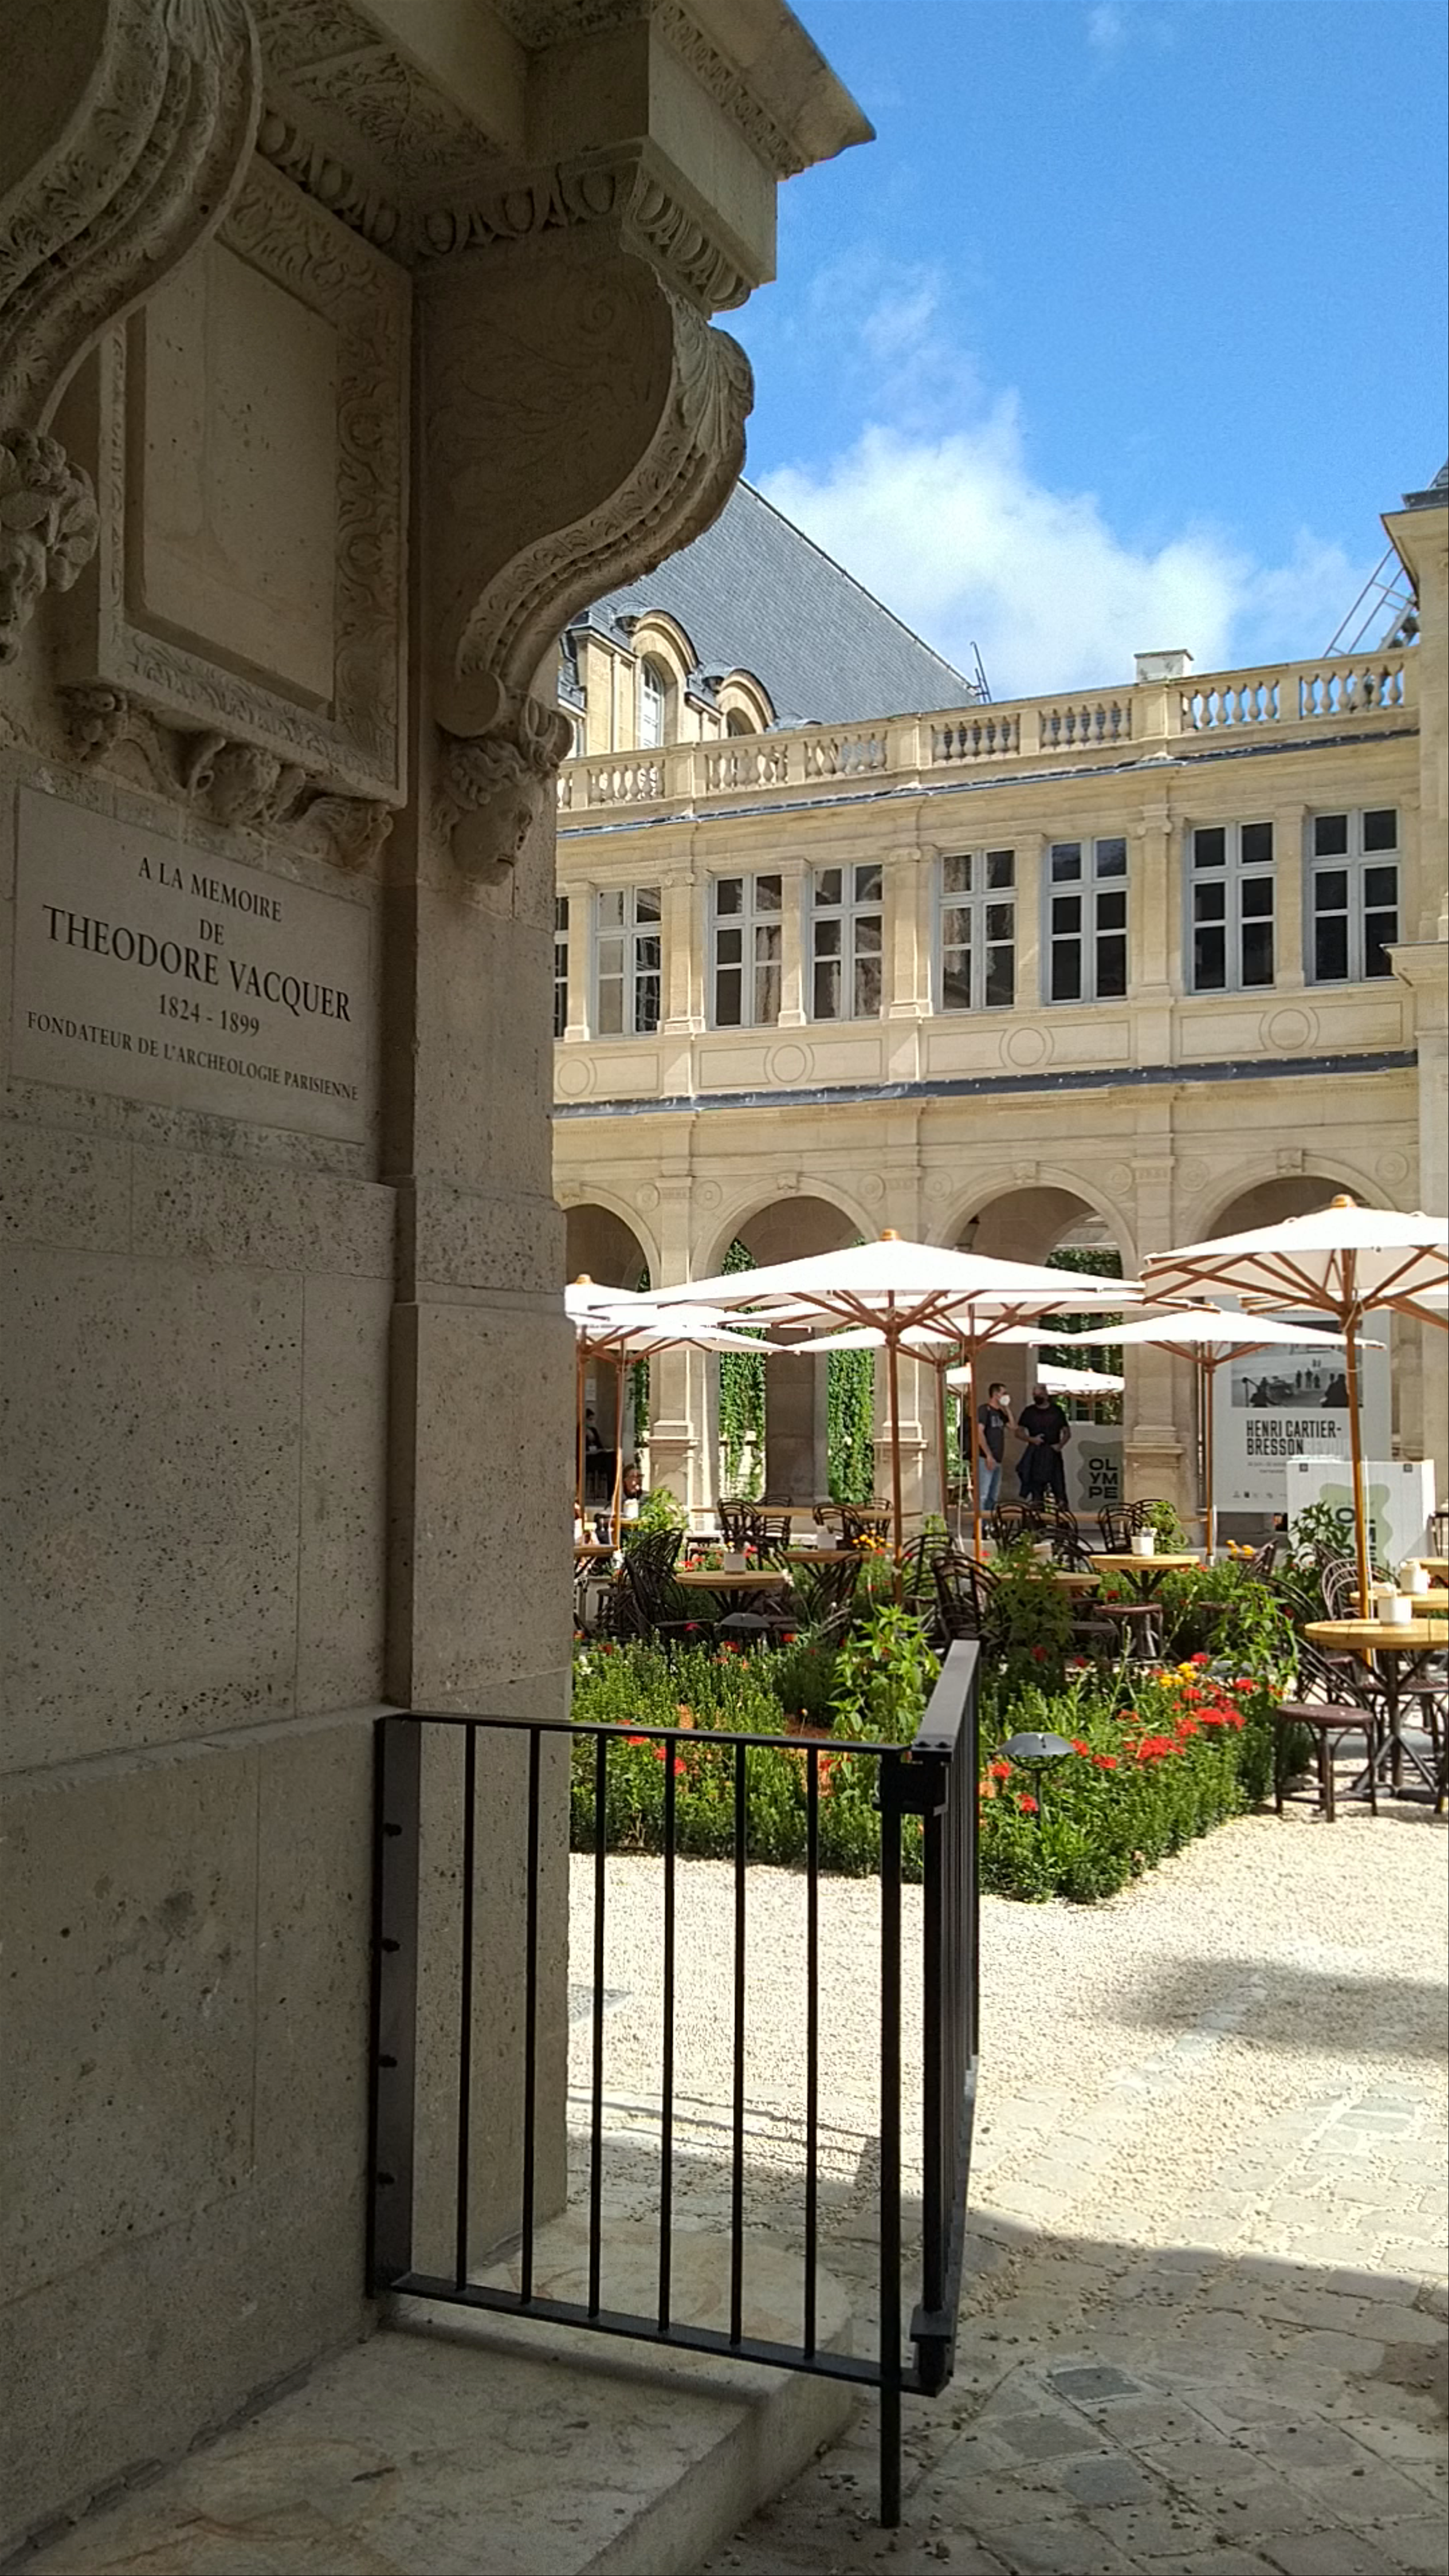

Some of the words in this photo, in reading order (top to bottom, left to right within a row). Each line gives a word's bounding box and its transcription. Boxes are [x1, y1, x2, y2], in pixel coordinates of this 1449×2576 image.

[138, 857, 151, 879] A
[160, 863, 183, 890] LA
[191, 874, 282, 922] MEMOIRE
[200, 919, 225, 945] DE
[43, 904, 219, 986] THEODORE
[229, 960, 351, 1022] VACQUER
[159, 994, 200, 1023] 1824
[221, 1010, 260, 1037] 1899
[28, 1011, 132, 1051] FONDATEUR
[138, 1038, 158, 1057] DE
[164, 1044, 280, 1084] L'ARCHEOLOGIE
[285, 1071, 358, 1100] PARISIENNE
[1246, 1420, 1282, 1438] HENRI
[1286, 1420, 1341, 1438] CARTIER-
[1247, 1438, 1304, 1455] BRESSON
